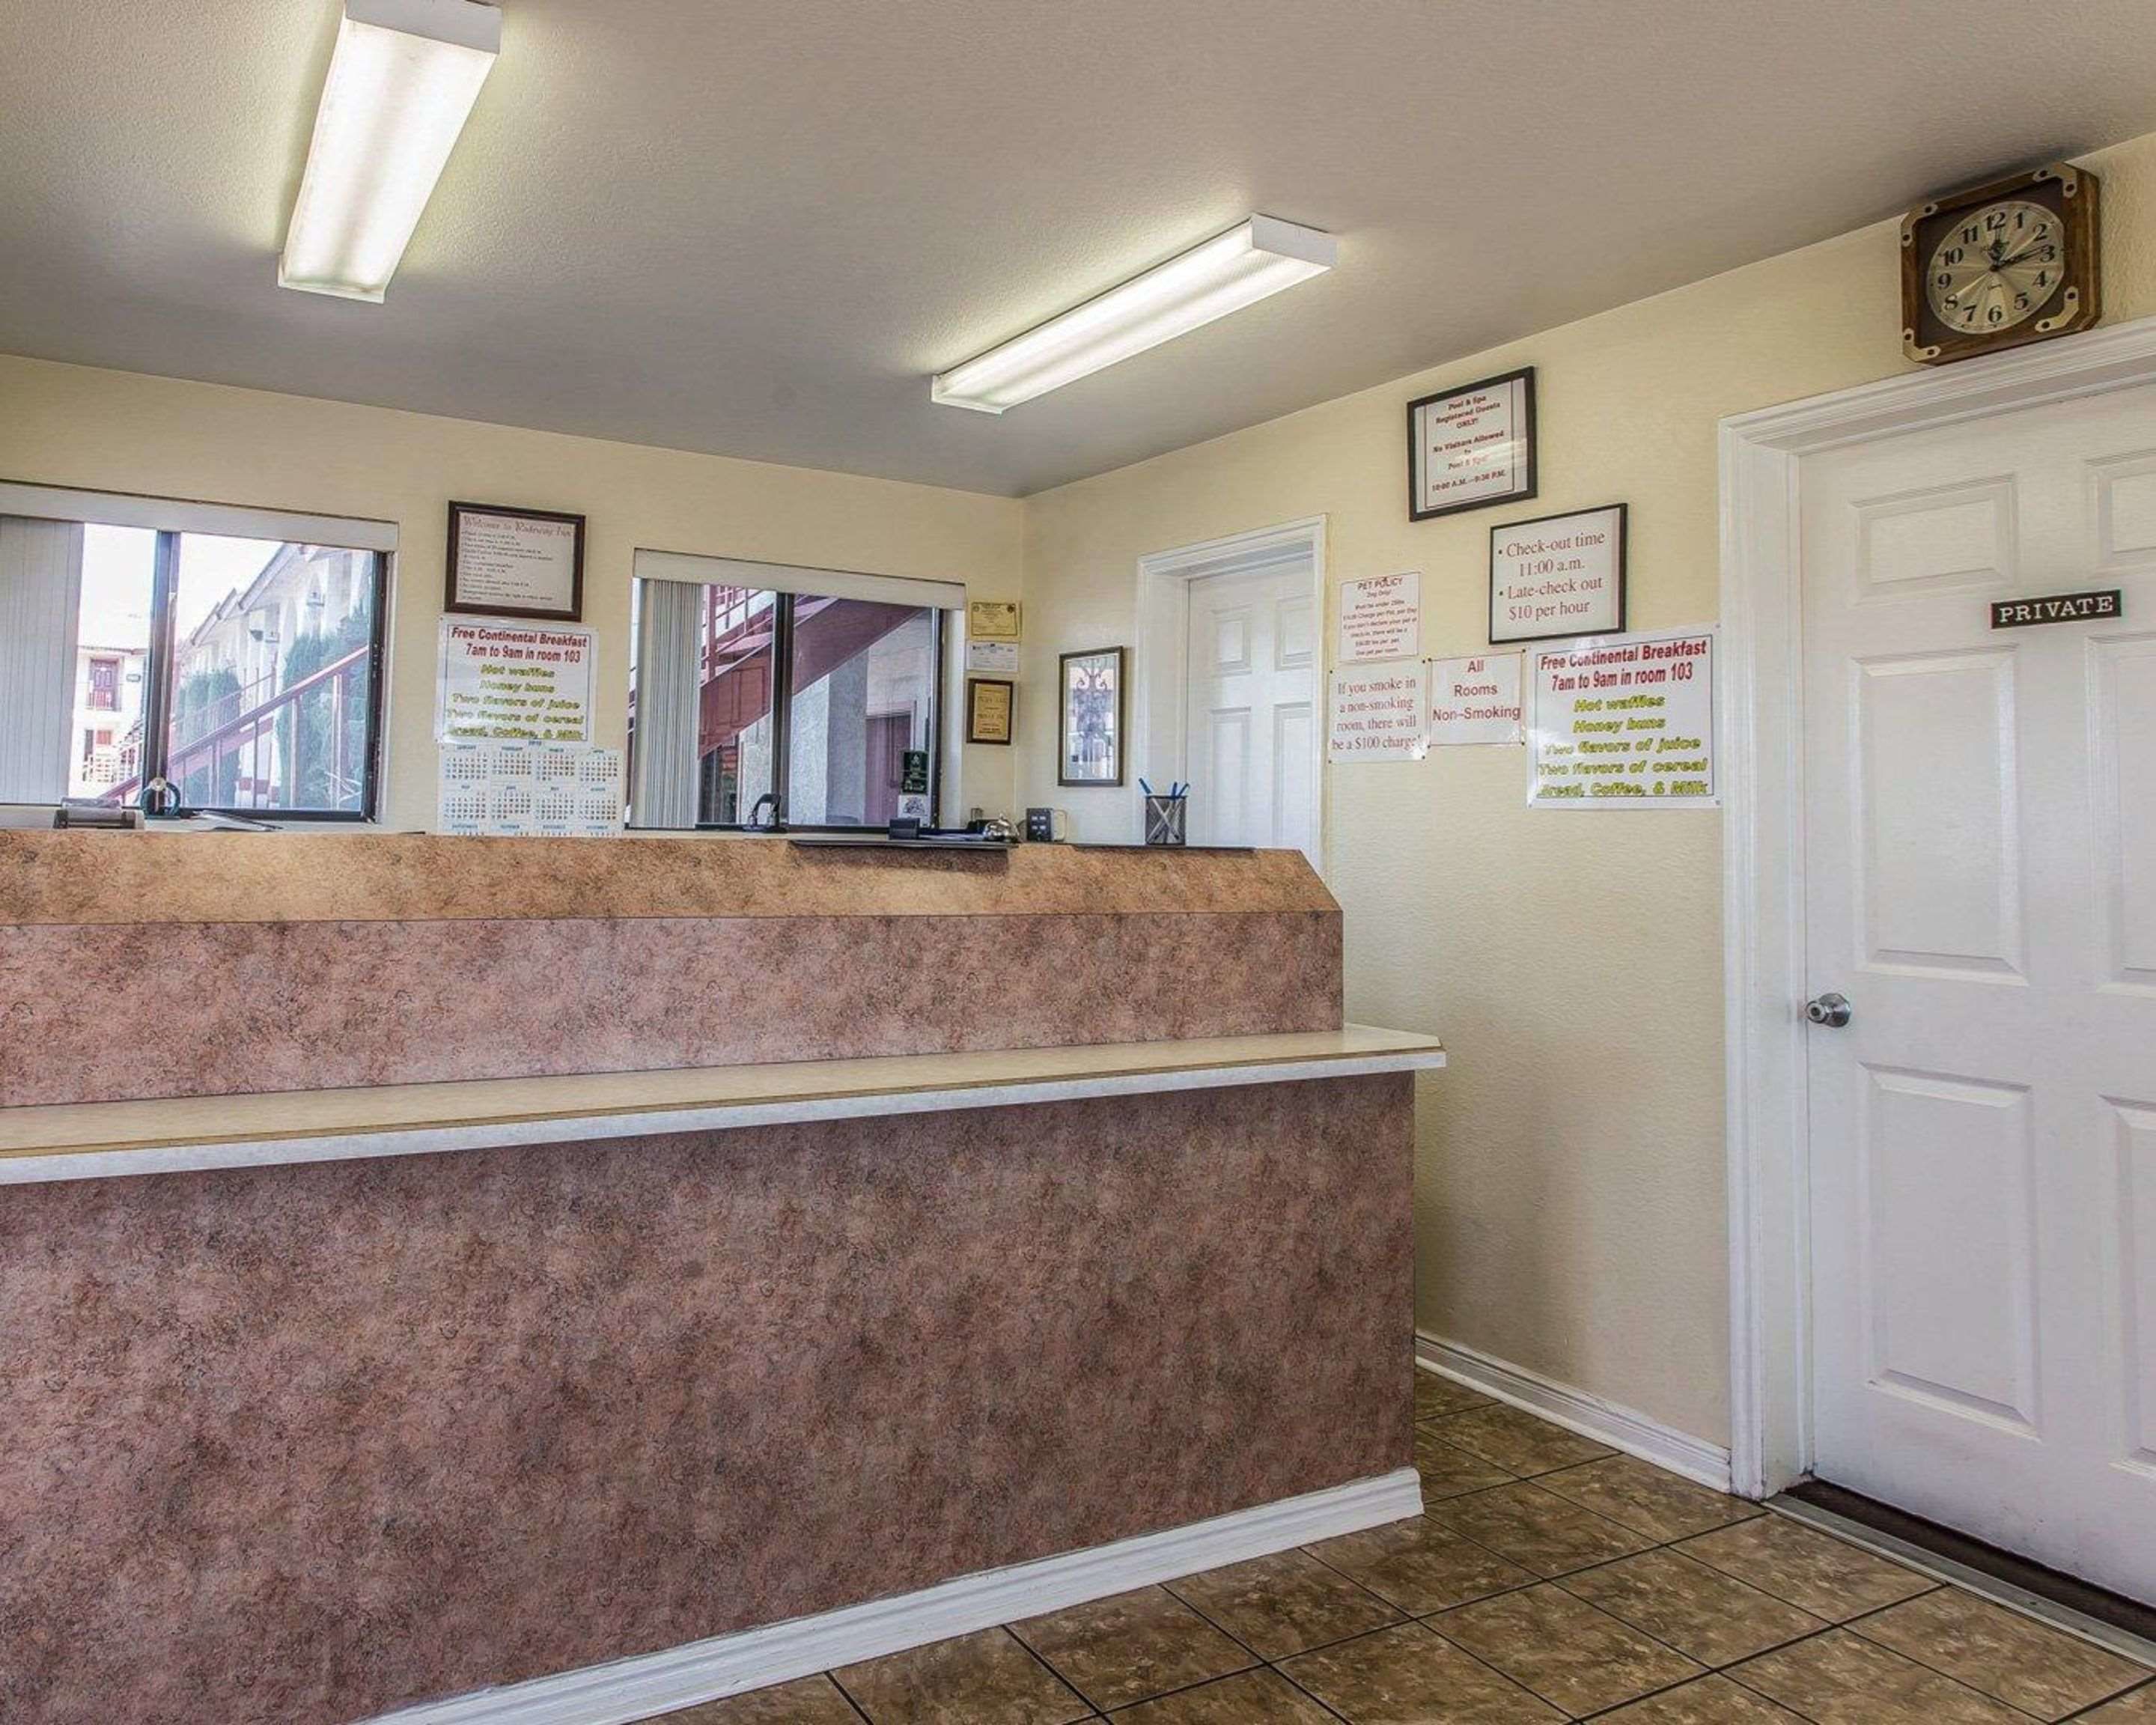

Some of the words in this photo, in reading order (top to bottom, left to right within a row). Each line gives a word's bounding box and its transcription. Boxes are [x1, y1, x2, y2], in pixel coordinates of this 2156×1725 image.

[1985, 212, 2006, 231] 12
[2013, 213, 2024, 228] 1
[1961, 225, 1978, 244] 11
[2033, 223, 2047, 241] 2
[1939, 247, 1964, 266] 10
[2039, 245, 2054, 261] 3
[1938, 273, 1952, 288] 9
[2033, 271, 2048, 288] 4
[1944, 294, 1958, 310] 8
[2014, 292, 2028, 310] 5
[1964, 305, 1976, 322] 7
[1988, 305, 2001, 322] 6
[1507, 538, 1571, 557] Check-out
[1575, 532, 1605, 547] time
[1520, 559, 1553, 576] 11:00
[1557, 559, 1585, 571] a.m.
[1508, 579, 1576, 599] Late-check
[1581, 578, 1602, 590] out
[1509, 605, 1532, 620] $10
[1535, 606, 1556, 621] per
[1560, 602, 1590, 615] hour
[1999, 596, 2113, 623] PRIVATE
[451, 627, 475, 639] Free
[479, 629, 536, 644] Continental
[540, 633, 587, 647] Breakfast
[466, 643, 486, 656] 7am
[490, 646, 500, 657] to
[503, 645, 523, 659] 9am
[526, 647, 534, 659] in
[537, 651, 561, 662] room
[564, 650, 581, 663] 103
[1541, 656, 1565, 669] Free
[1570, 647, 1638, 666] Continental
[1642, 640, 1706, 660] Breakfast
[1468, 660, 1484, 672] All
[1552, 675, 1574, 691] 7am
[1578, 675, 1589, 689] to
[1594, 671, 1617, 687] 9am
[1621, 668, 1631, 685] in
[1635, 669, 1666, 684] room
[1671, 663, 1693, 681] 103
[1339, 683, 1346, 694] If
[1348, 684, 1365, 696] you
[1369, 678, 1402, 692] smoke
[1405, 676, 1416, 688] in
[1454, 684, 1497, 696] Rooms
[1340, 704, 1345, 713] a
[1348, 696, 1413, 712] non-smoking
[1574, 699, 1602, 712] Hot
[1606, 695, 1665, 710] waffles
[1433, 705, 1521, 720] Non-Smoking
[1336, 722, 1365, 731] room,
[1368, 718, 1392, 729] there
[1395, 714, 1416, 727] will
[1332, 738, 1344, 749] be
[1347, 741, 1351, 749] a
[1356, 737, 1380, 749] $100
[1657, 737, 1701, 753] juice
